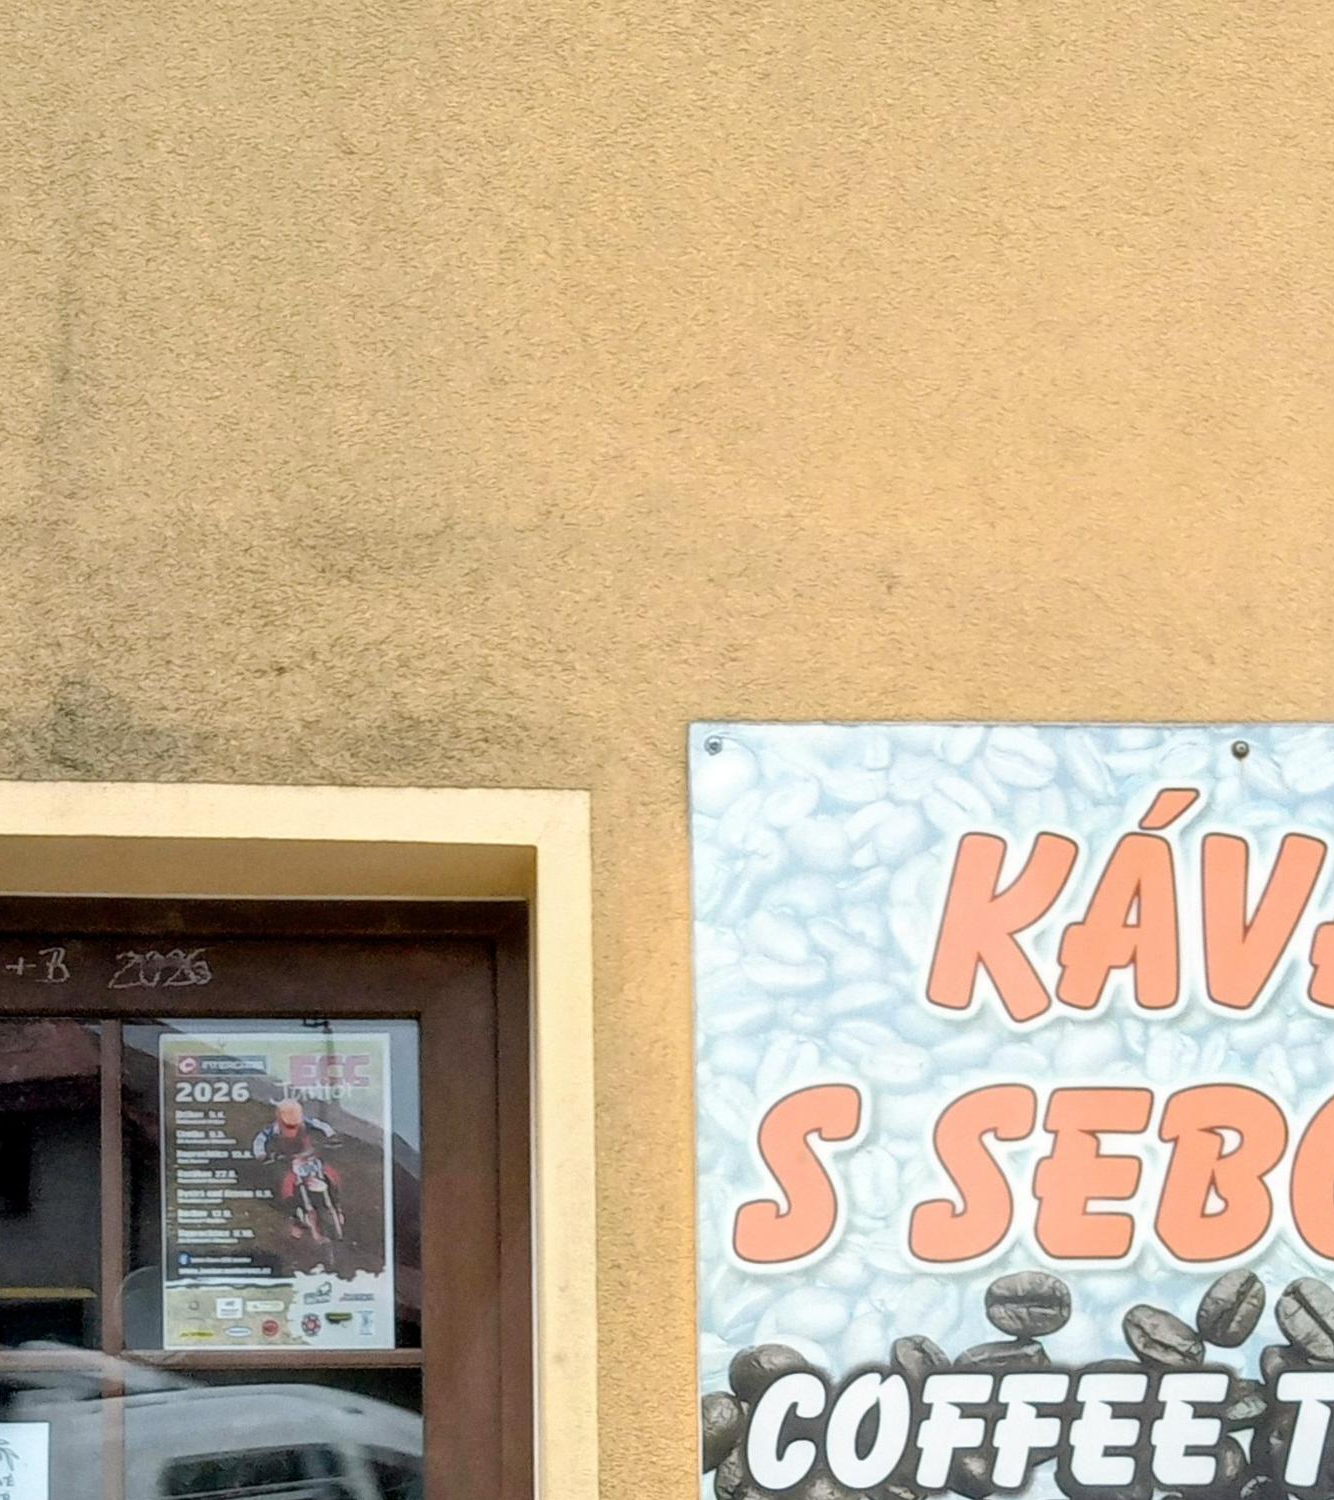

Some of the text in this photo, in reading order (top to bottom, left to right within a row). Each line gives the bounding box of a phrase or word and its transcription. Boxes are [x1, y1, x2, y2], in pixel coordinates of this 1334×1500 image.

[175, 1081, 251, 1104] 2026
[733, 1082, 862, 1263] S
[746, 1370, 1232, 1489] COFFEE
